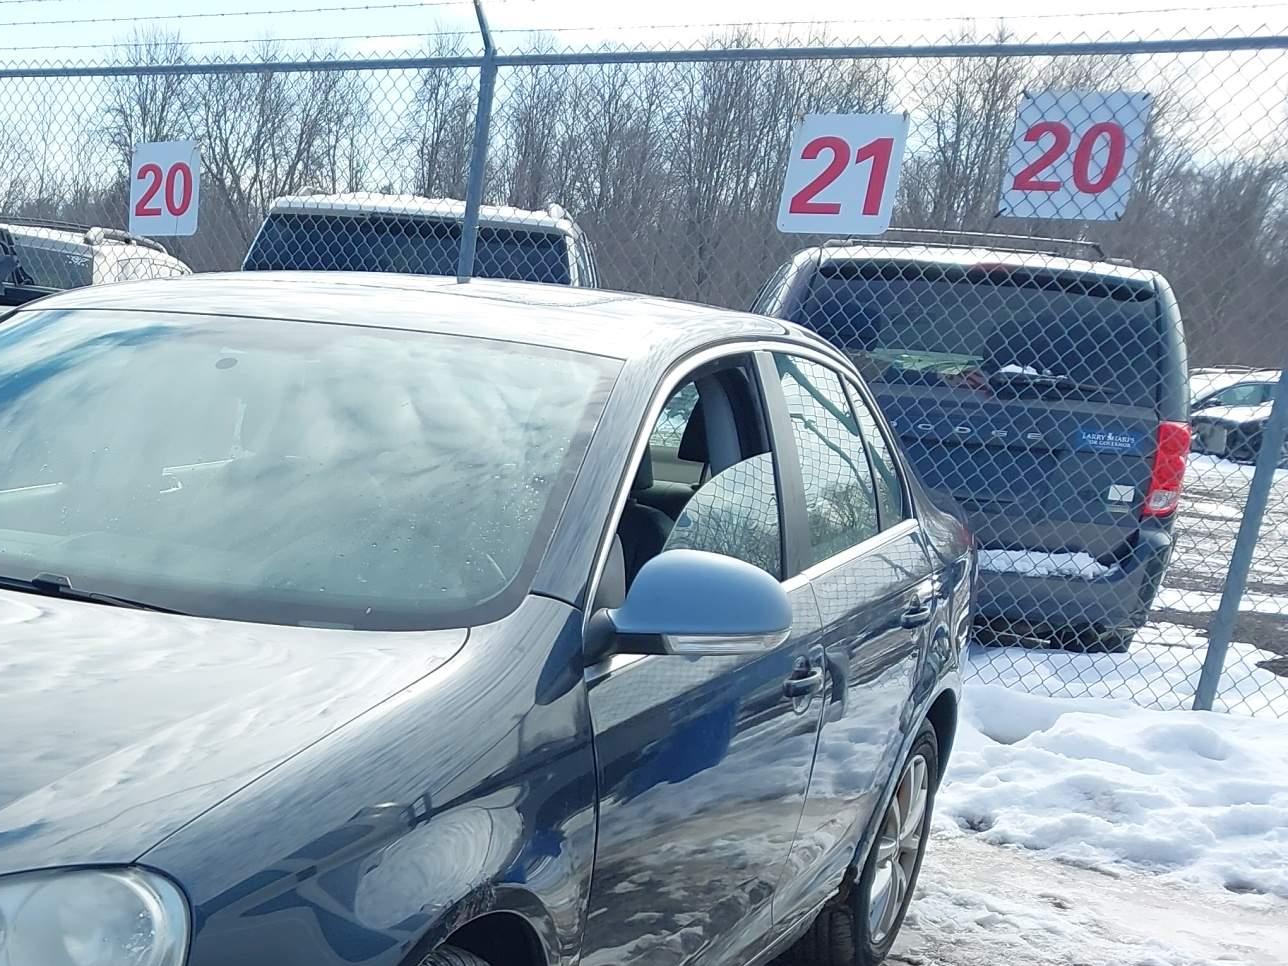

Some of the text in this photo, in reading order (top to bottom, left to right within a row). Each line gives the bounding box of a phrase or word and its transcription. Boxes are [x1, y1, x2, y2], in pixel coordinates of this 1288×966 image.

[135, 164, 192, 217] 20
[789, 136, 894, 216] 21
[1012, 121, 1126, 193] 20
